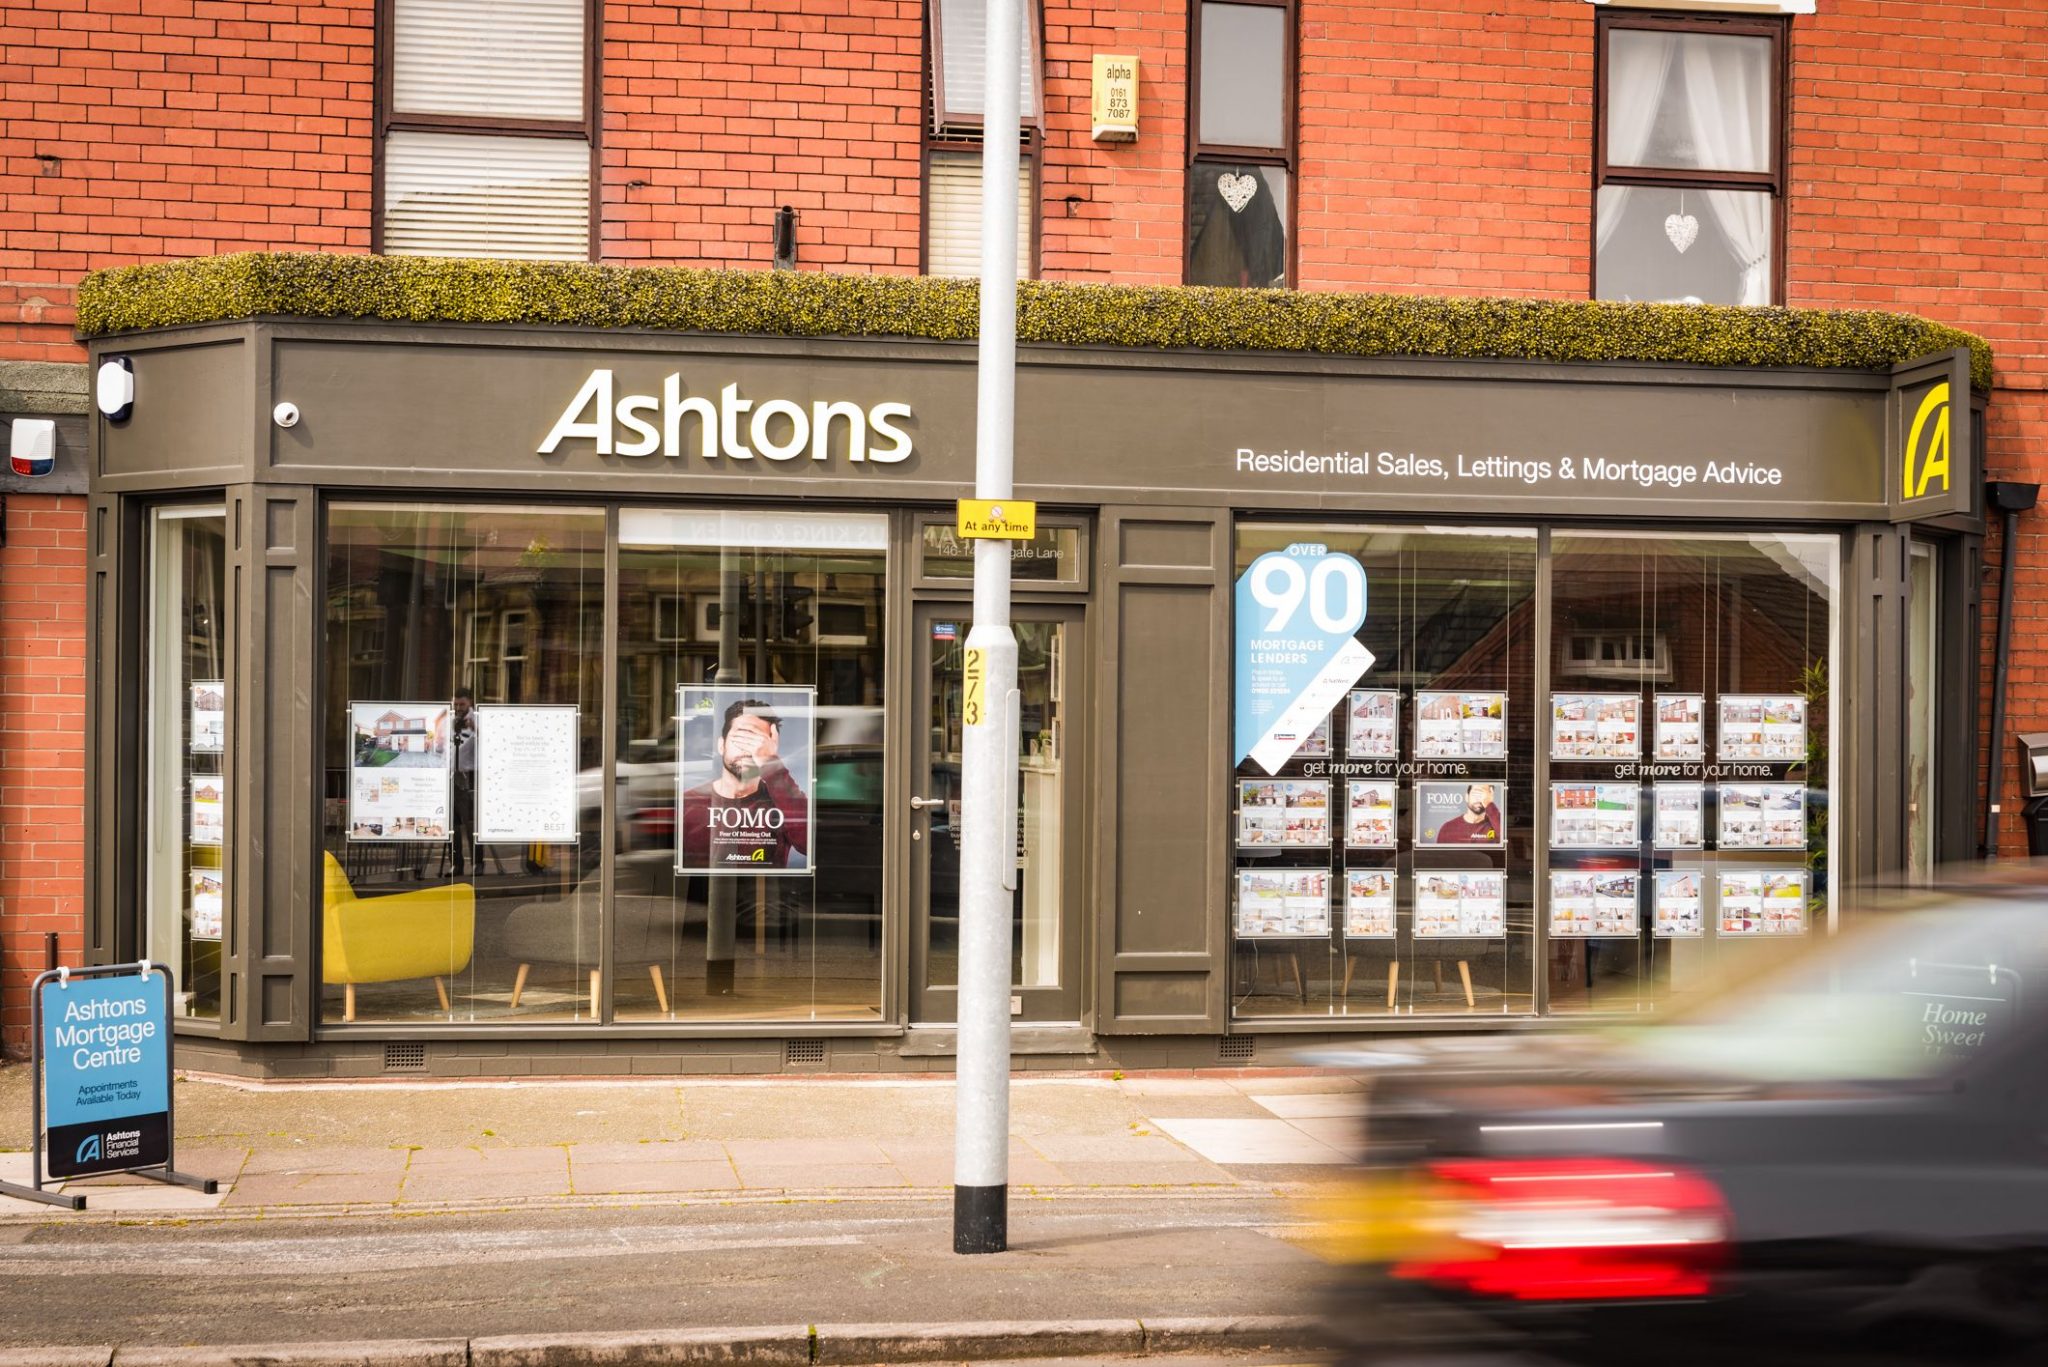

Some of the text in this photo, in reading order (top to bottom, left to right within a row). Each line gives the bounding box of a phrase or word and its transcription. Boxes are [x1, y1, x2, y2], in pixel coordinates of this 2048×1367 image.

[1106, 64, 1131, 83] alpha
[1110, 87, 1127, 98] 0161
[1109, 98, 1128, 108] 873
[536, 368, 913, 464] Ashtons
[1235, 448, 1782, 488] Residential Sales, Lettings & Mortgage Advice
[964, 520, 1029, 534] At any time
[937, 545, 1064, 560] 146-14 gate Lane
[1289, 543, 1326, 557] OVER
[1250, 556, 1364, 635] 90
[1250, 639, 1324, 651] MORTGAGE
[1250, 652, 1309, 665] LENDERS
[1303, 760, 1470, 778] get more for your home.
[1614, 762, 1774, 779] get more for your home.
[1426, 792, 1464, 805] FOMO
[706, 807, 785, 829] FOMO
[725, 853, 752, 861] Ashtons
[64, 998, 147, 1023] Ashtons
[1921, 1003, 1987, 1026] Home
[55, 1019, 156, 1048] Mortgage
[1922, 1023, 1986, 1047] Sweet
[73, 1046, 141, 1071] Centre
[78, 1080, 138, 1096] Appointments
[76, 1089, 142, 1107] Available Today
[106, 1130, 141, 1142] Ashtons
[106, 1138, 139, 1150] Financial
[106, 1147, 139, 1159] Services
